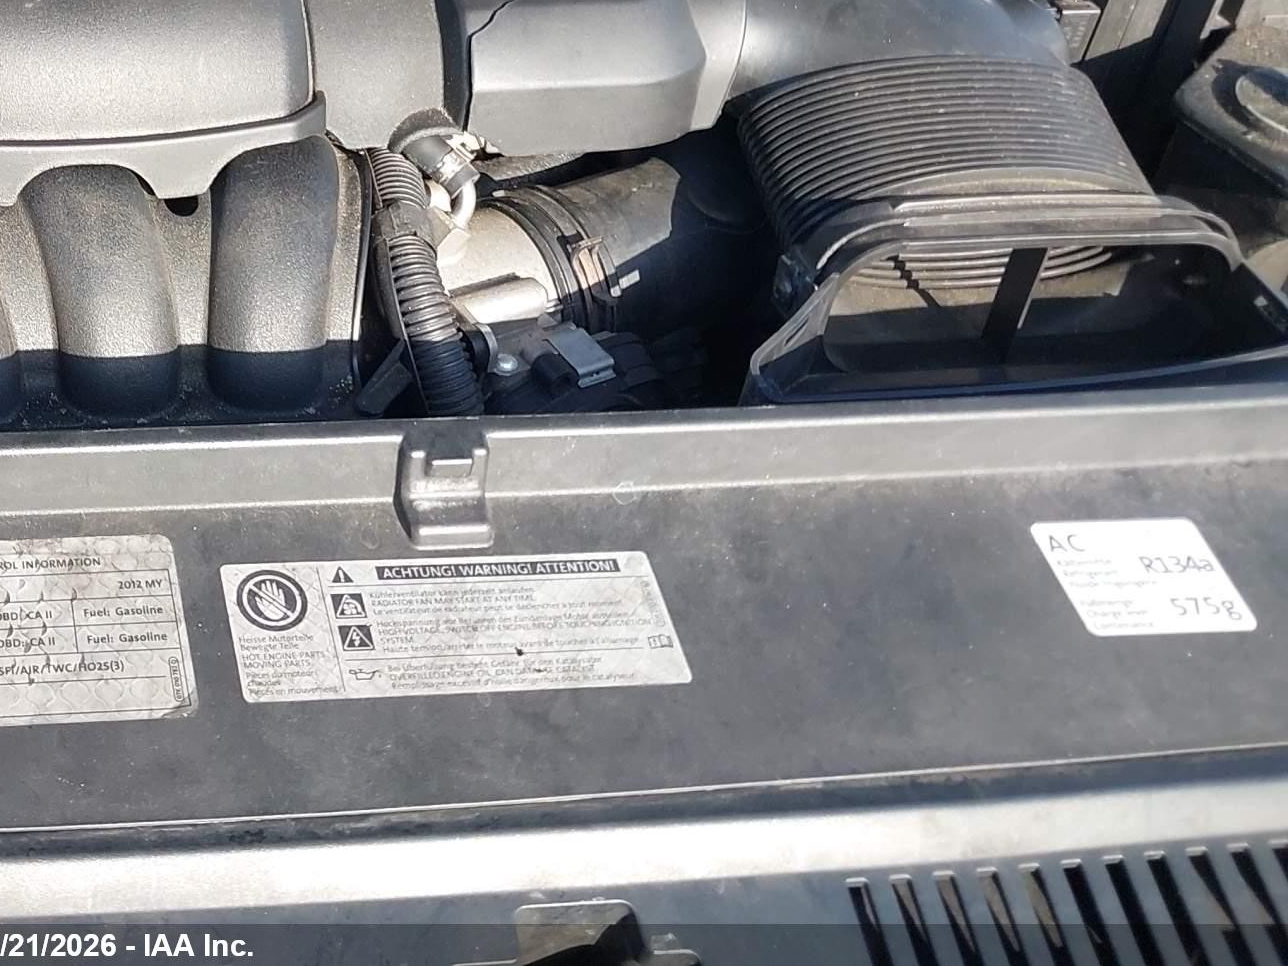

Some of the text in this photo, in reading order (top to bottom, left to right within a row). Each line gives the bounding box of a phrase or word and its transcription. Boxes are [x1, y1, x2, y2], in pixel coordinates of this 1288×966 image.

[1048, 534, 1086, 552] AC
[22, 557, 102, 570] INFORMATION
[383, 560, 616, 579] ACHTUNG! WARNING! ATTENTION!
[1139, 555, 1215, 573] R134a
[119, 578, 164, 590] 2012 MY
[27, 610, 43, 620] CA
[83, 606, 164, 618] Fuel: Gasoline
[30, 636, 46, 647] CA
[87, 632, 168, 644] Fuel: Gasoline
[242, 653, 262, 662] HOT
